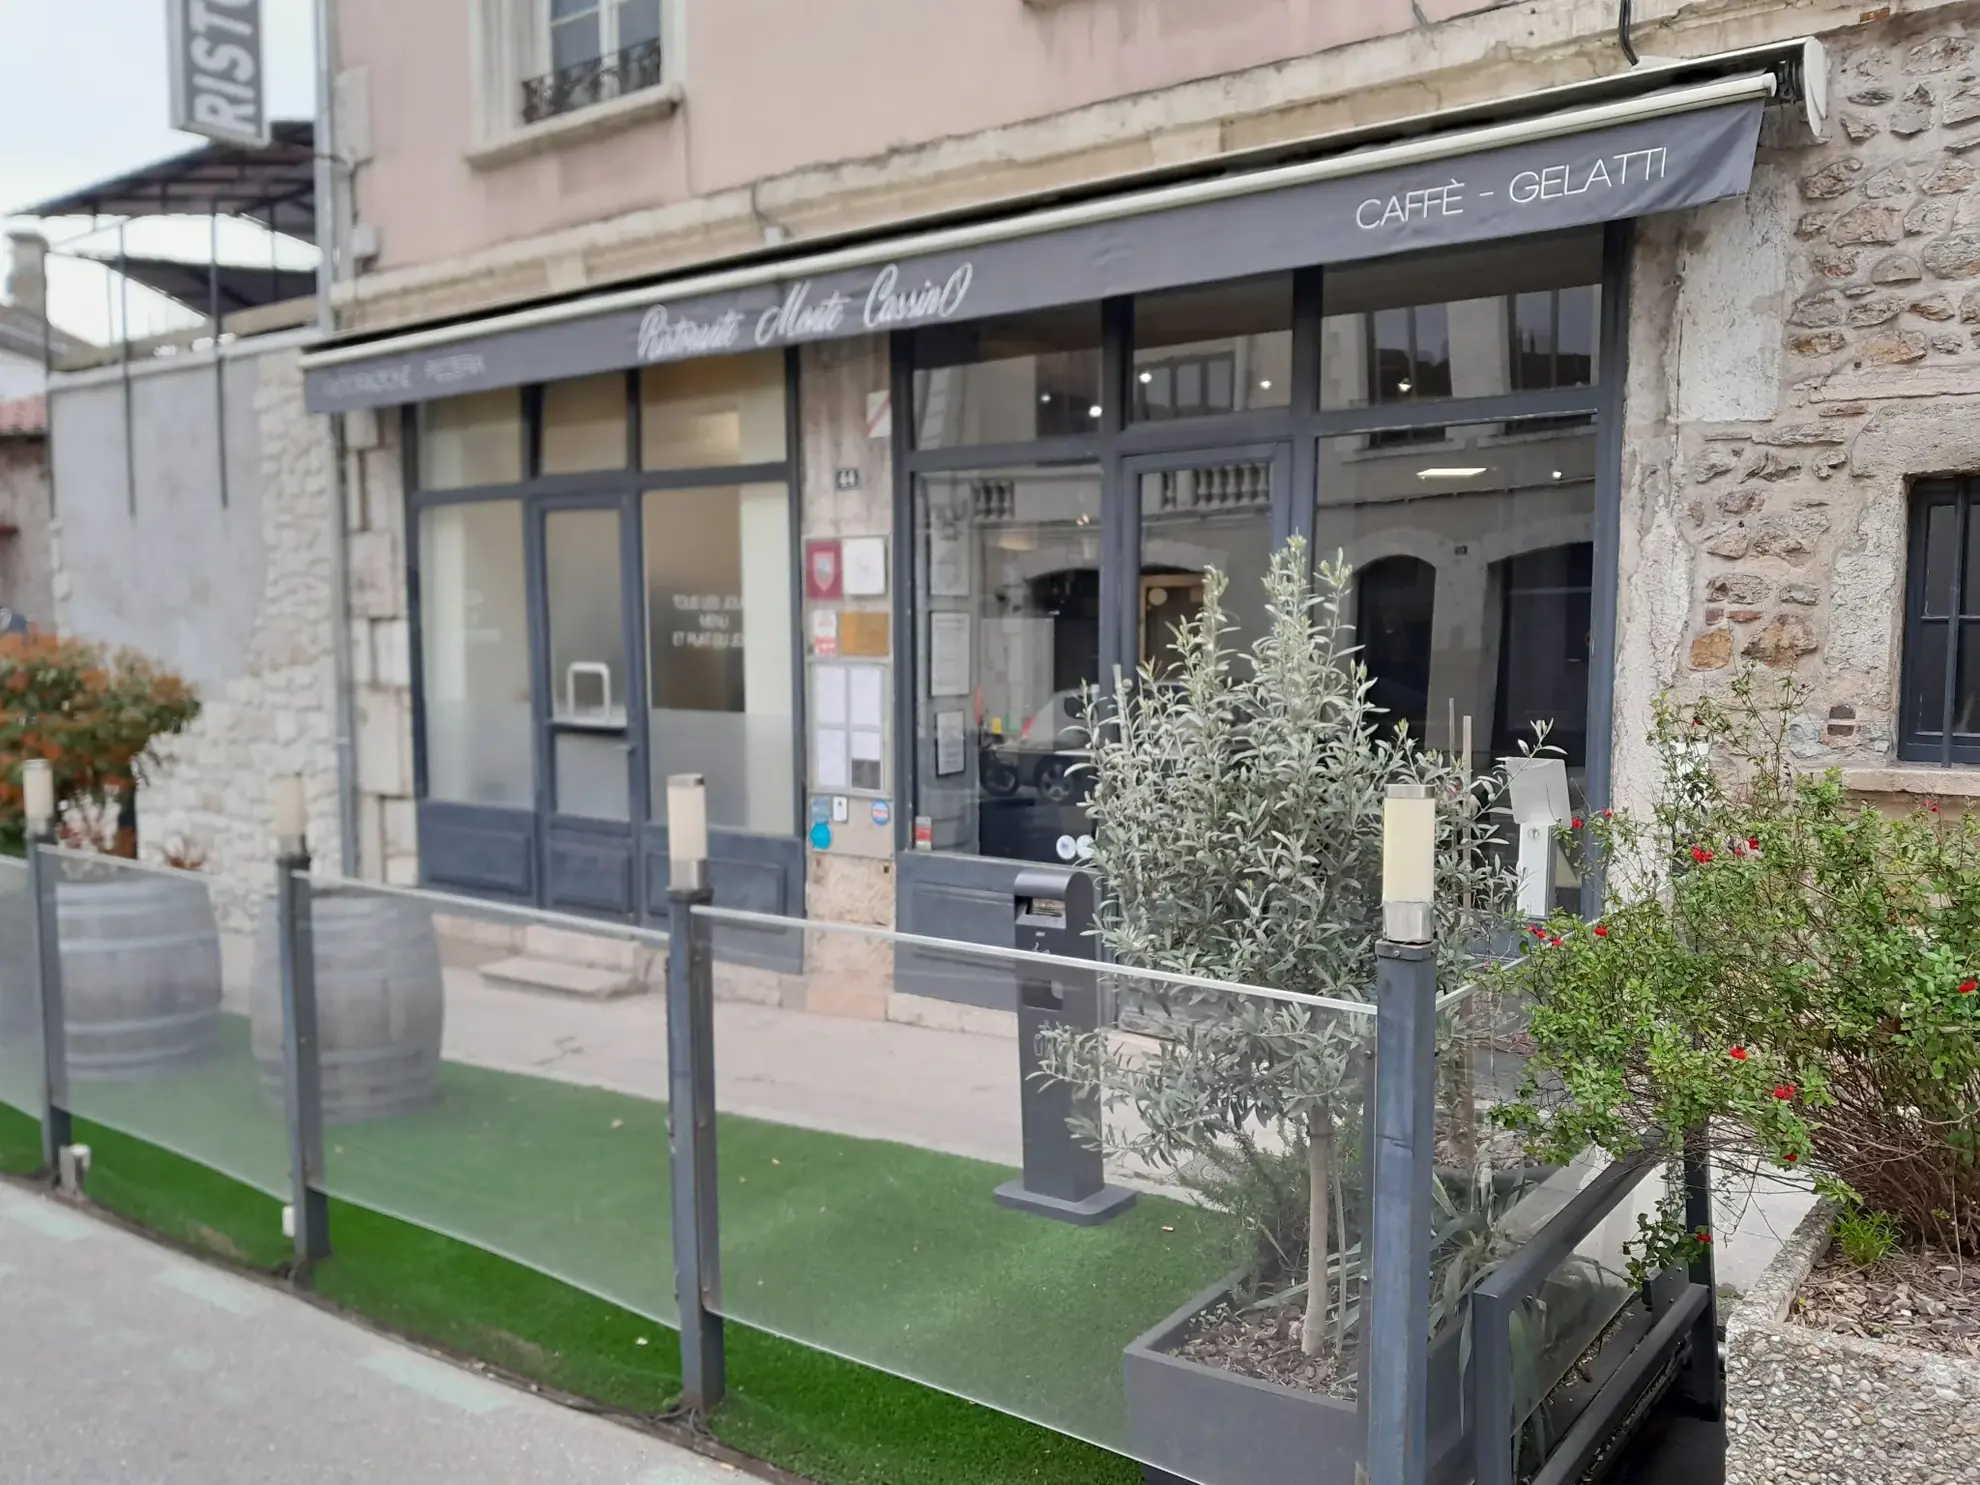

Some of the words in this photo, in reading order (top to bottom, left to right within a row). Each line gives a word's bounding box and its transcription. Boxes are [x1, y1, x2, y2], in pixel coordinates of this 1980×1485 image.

[188, 0, 256, 134] RIST
[1355, 177, 1466, 230] CAFFÈ
[1508, 146, 1668, 204] GELATTI
